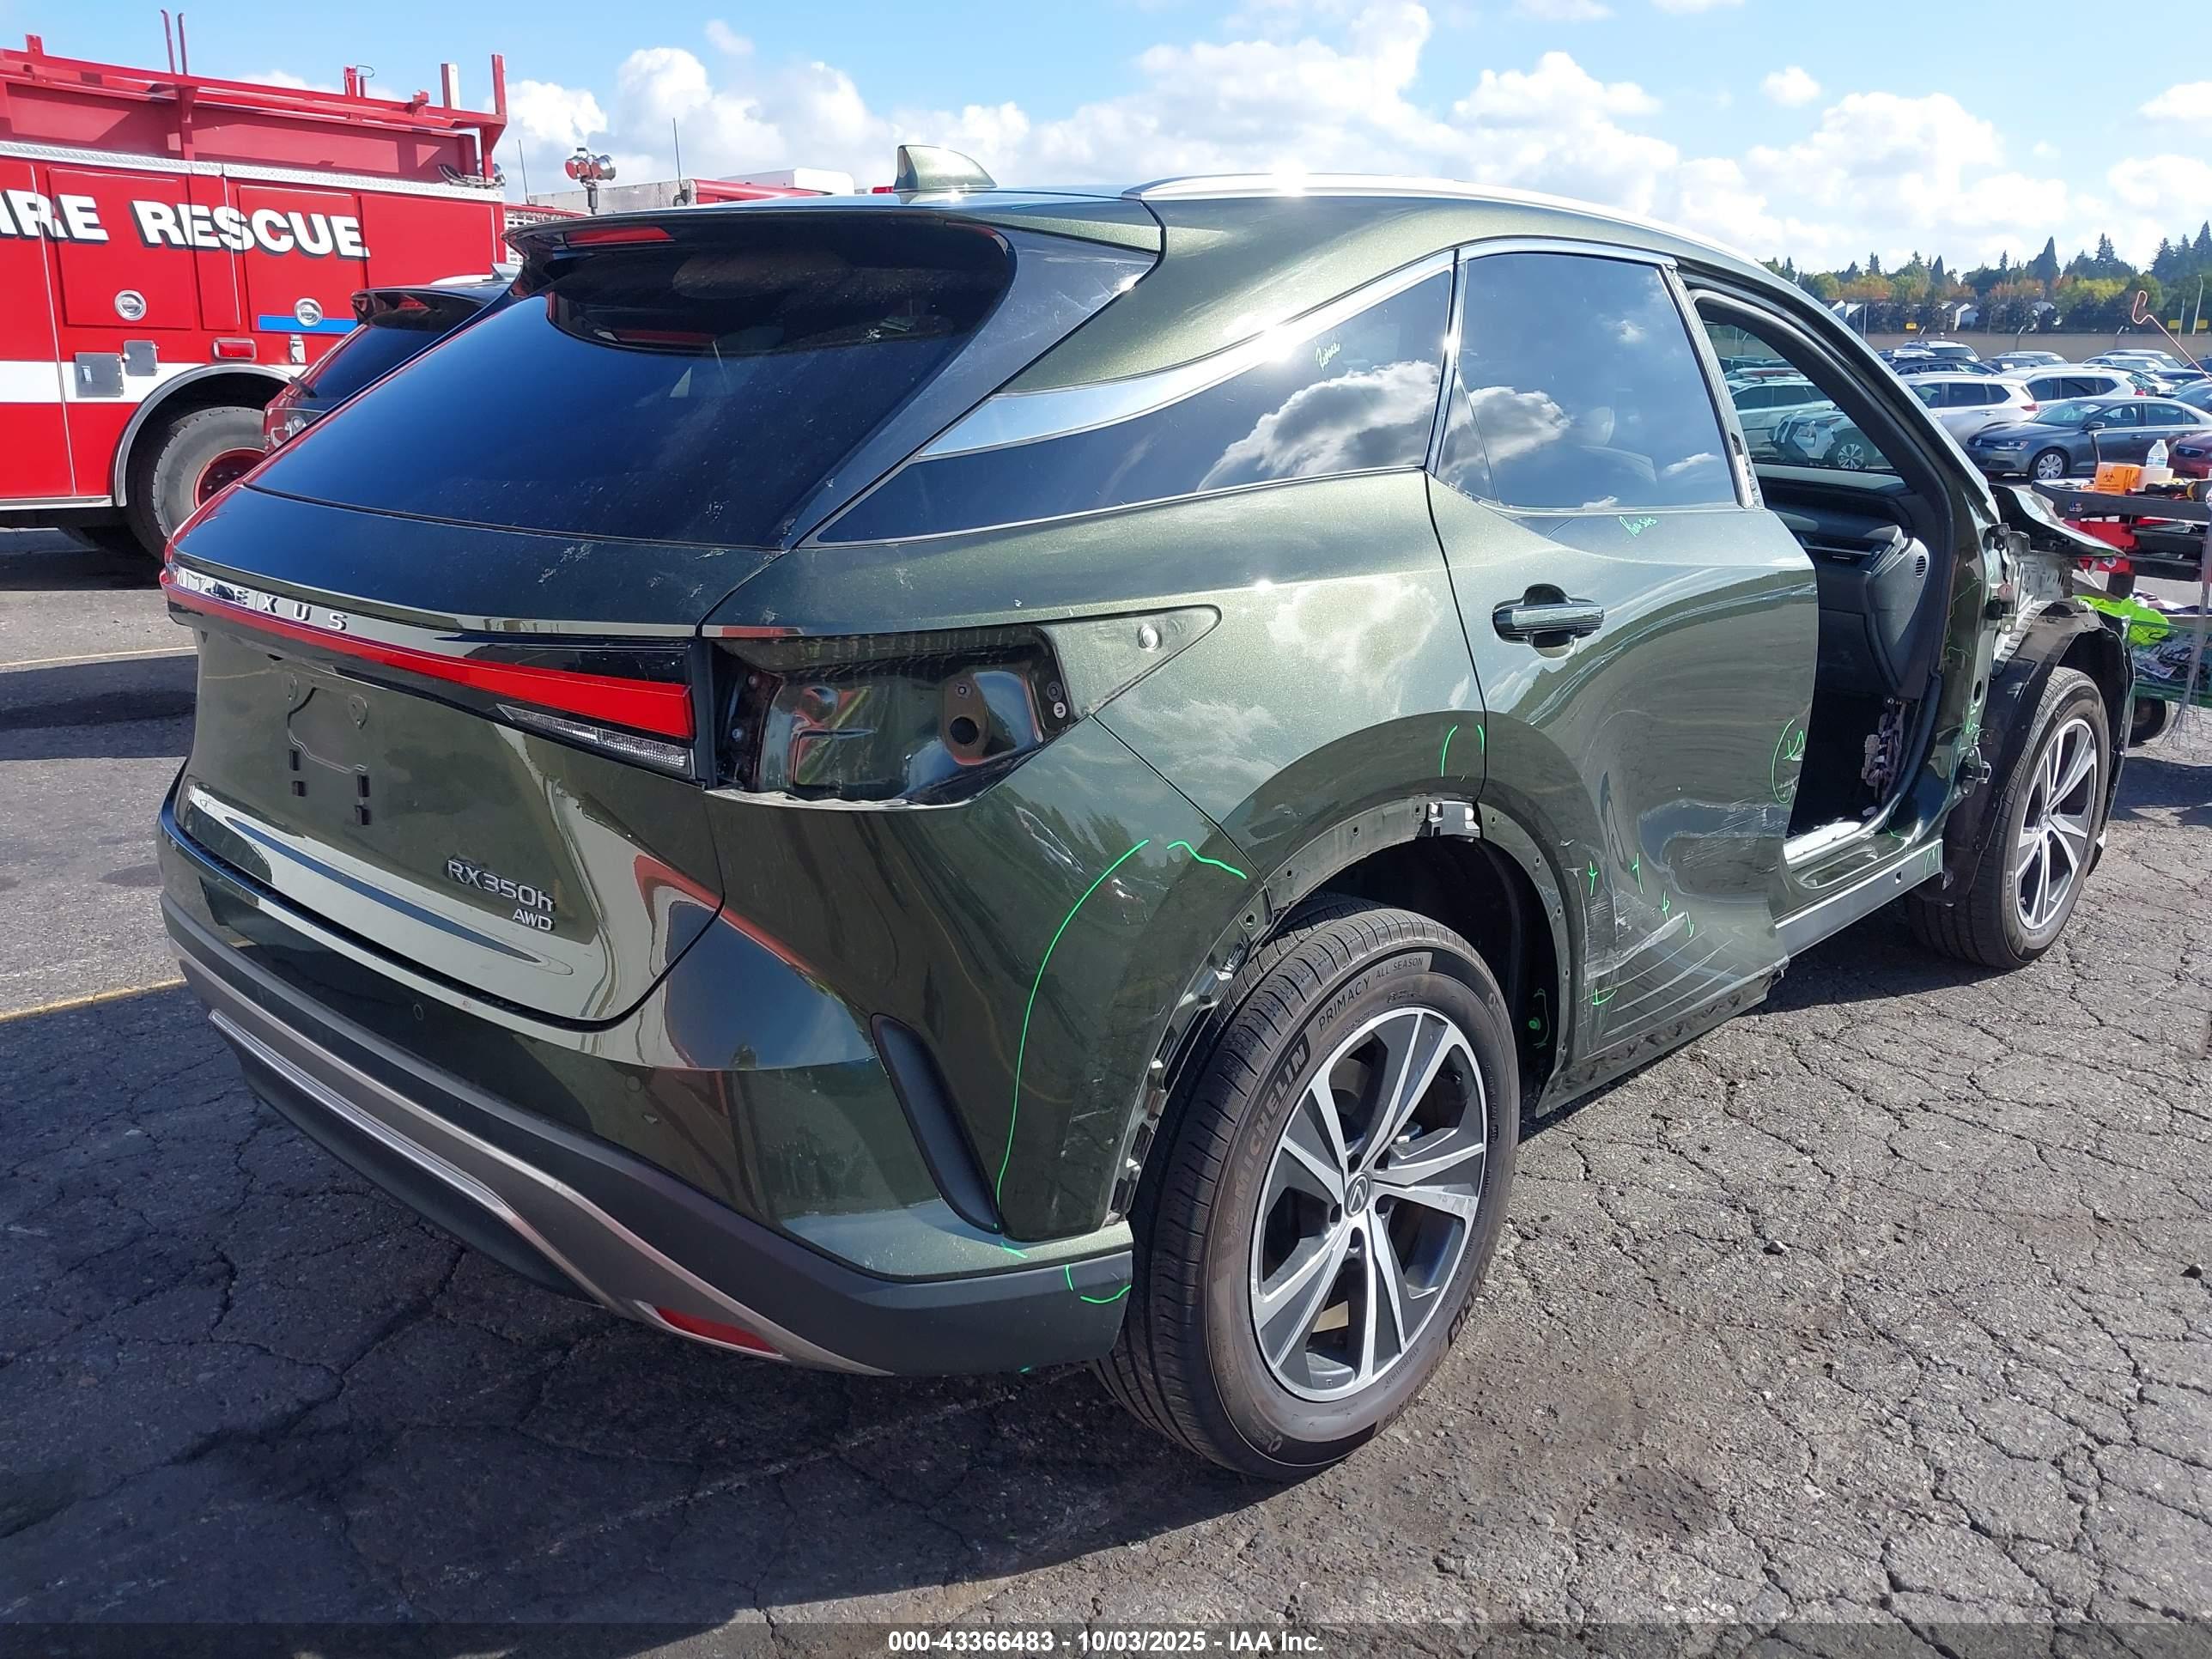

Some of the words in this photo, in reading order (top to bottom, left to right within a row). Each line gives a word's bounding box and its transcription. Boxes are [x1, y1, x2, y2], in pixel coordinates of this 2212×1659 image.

[131, 200, 371, 258] RESCUE
[210, 581, 348, 631] LEXUS
[447, 859, 556, 913] RX350h
[513, 908, 556, 932] AWD
[1318, 976, 1370, 1030] PRIMACY
[1376, 967, 1389, 980] ALL
[1393, 957, 1424, 972] SEASON
[1234, 1043, 1308, 1201] MICHELIN
